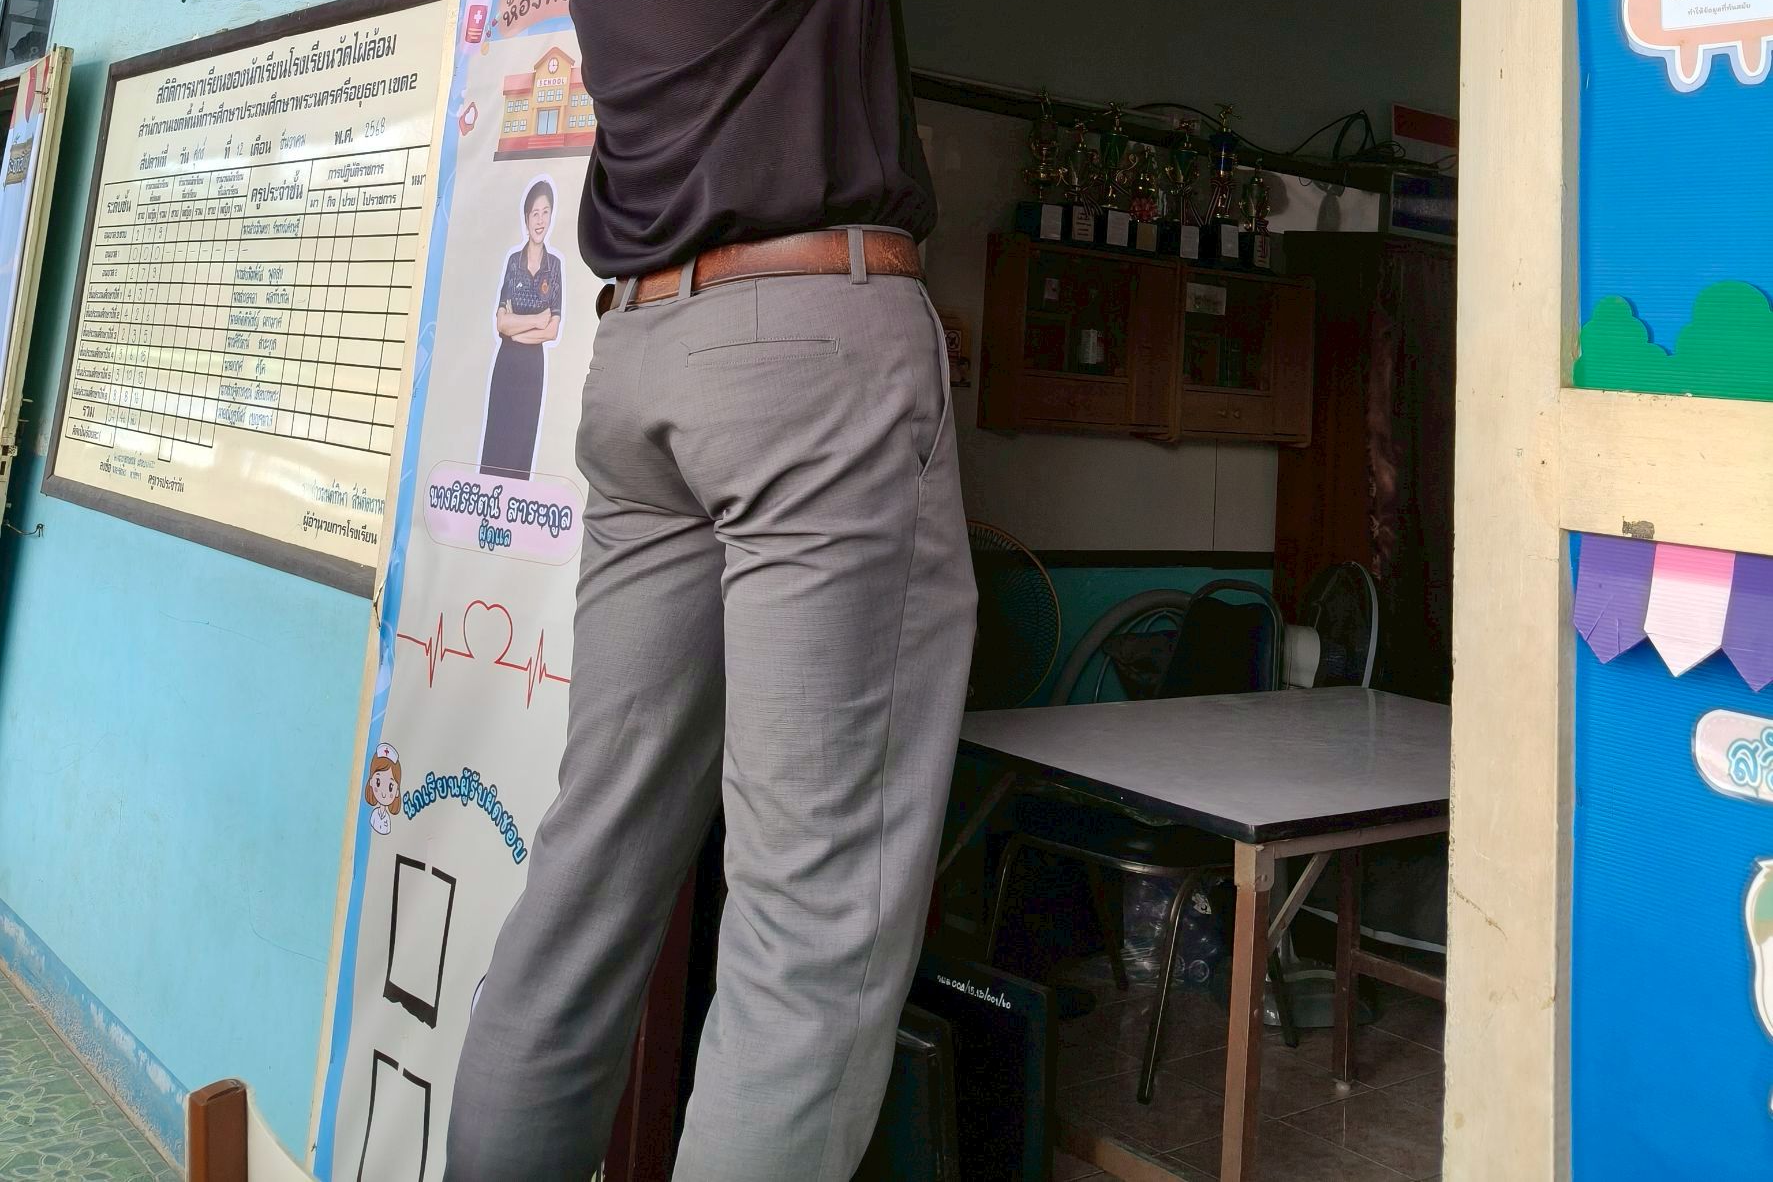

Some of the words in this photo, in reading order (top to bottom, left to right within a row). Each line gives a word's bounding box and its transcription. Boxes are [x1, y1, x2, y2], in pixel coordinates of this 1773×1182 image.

[539, 77, 565, 87] SCHOOL
[179, 146, 190, 166] วัน
[224, 137, 233, 159] ที่
[250, 135, 272, 158] เดือน
[334, 126, 353, 146] พ.ศ.
[365, 117, 386, 139] 2568
[250, 169, 303, 209] ครูประจำชั้น
[328, 162, 385, 182] การปฏิบัติราชการ
[326, 195, 336, 208] กิจ
[342, 192, 356, 208] ป่วย
[362, 191, 397, 207] ไปราชการ
[82, 404, 96, 419] รวม
[429, 480, 503, 519] นางศิริรัตน์
[507, 496, 573, 538] สาระกูล
[303, 510, 378, 545] ผู้อำนวยการโรงเรียน
[478, 518, 512, 551] ผู้ดูแล
[403, 767, 528, 865] นักเรียนผู้รับผิดชอบ
